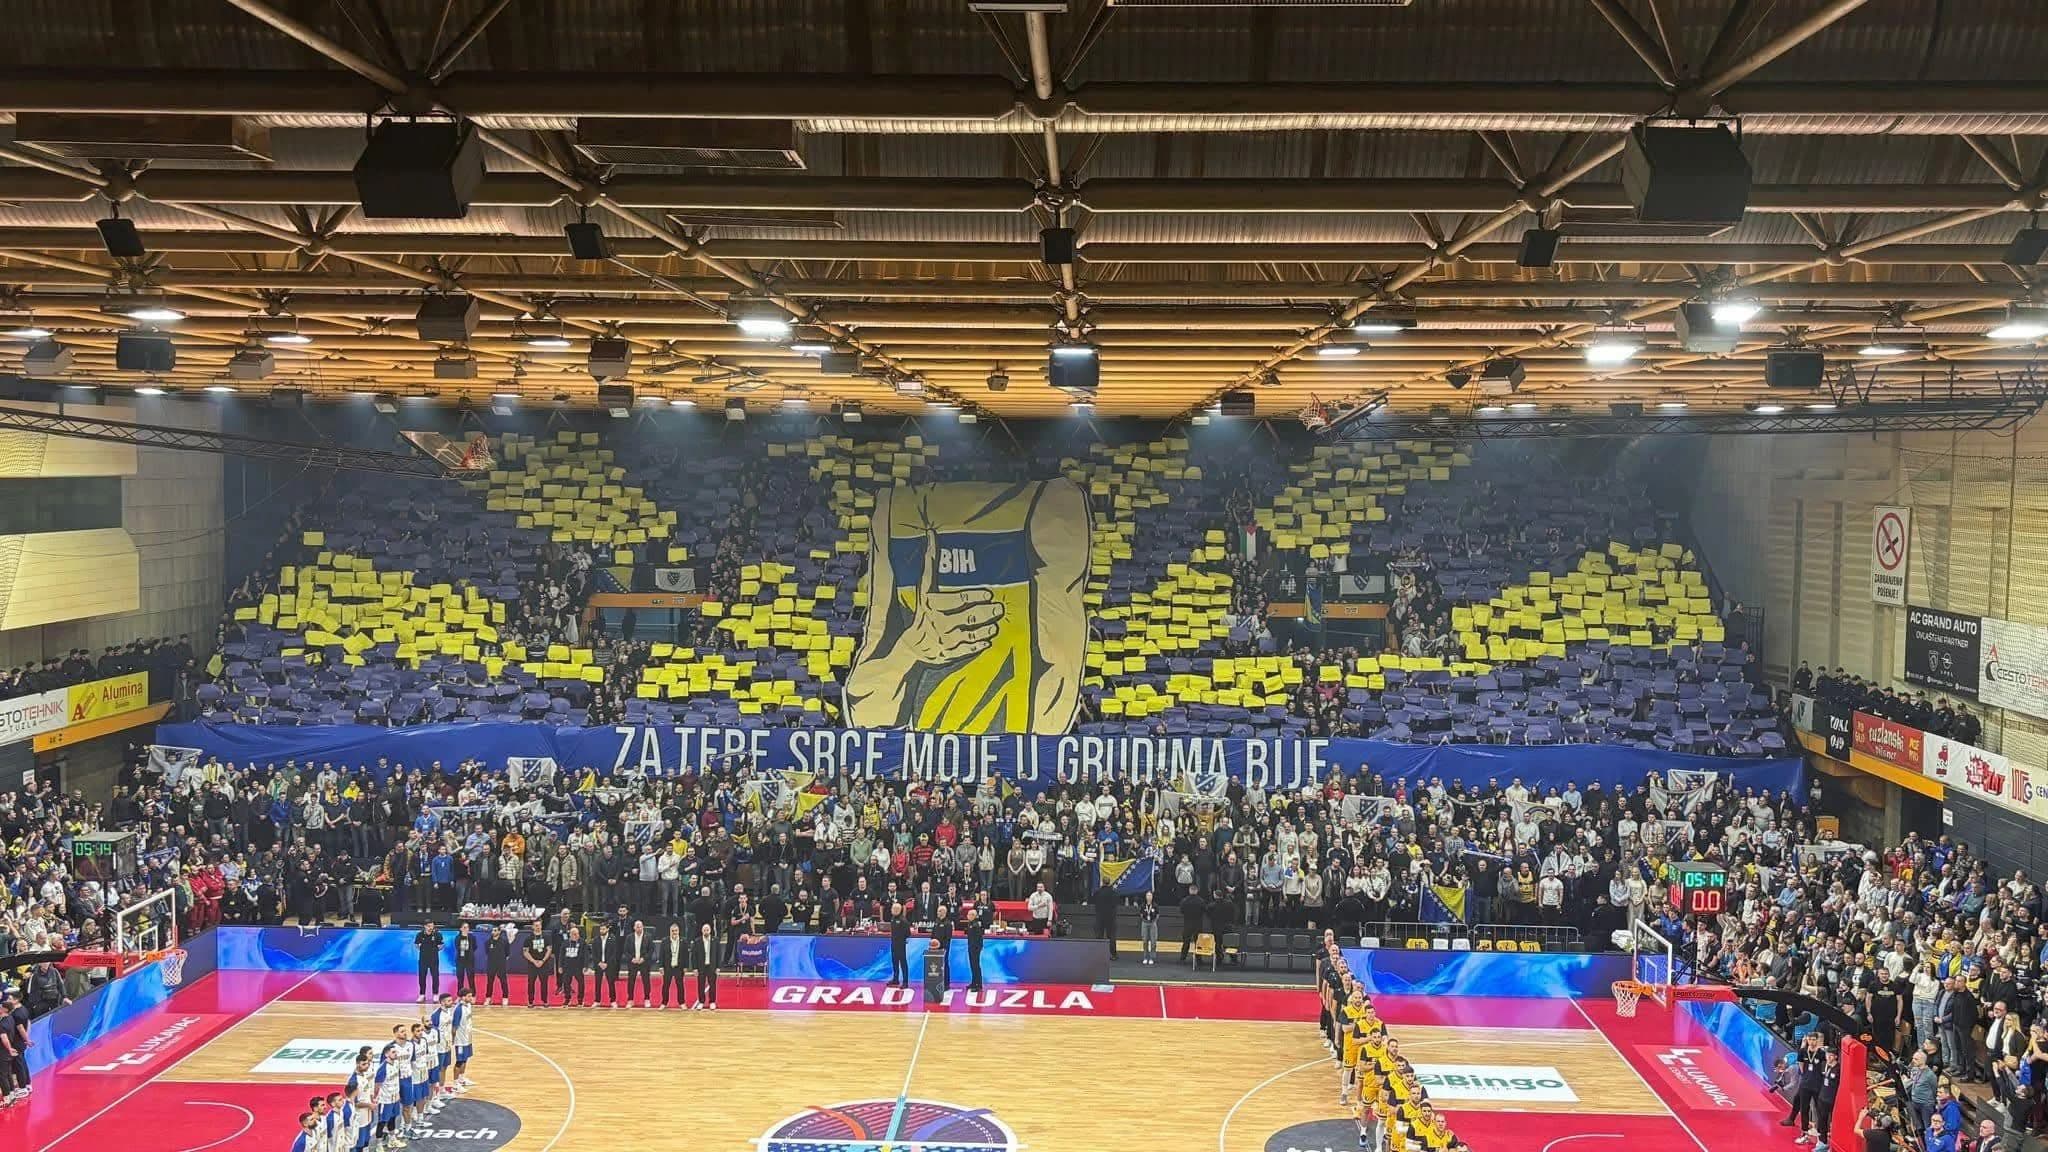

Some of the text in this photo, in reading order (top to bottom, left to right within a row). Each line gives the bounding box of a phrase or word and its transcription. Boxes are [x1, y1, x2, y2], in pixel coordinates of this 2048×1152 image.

[938, 548, 976, 574] BIH
[1910, 611, 1978, 635] AC GRAND AUTO
[102, 681, 143, 702] Alumina
[9, 720, 37, 732] TUZLA
[614, 727, 663, 775] ZA
[788, 731, 886, 781] SRCE
[902, 733, 1000, 784] MOJE
[1015, 735, 1040, 782] U
[1057, 737, 1229, 787] GRUDIMA
[1246, 738, 1330, 790] BIJE
[1685, 872, 1724, 887] 05:14
[1692, 890, 1721, 911] 0.0
[771, 985, 1094, 1009] GRAD TUZLA
[132, 1016, 201, 1052] LUKAVAC
[1441, 1074, 1564, 1090] Bingo
[1681, 1066, 1737, 1107] LUKAVAC
